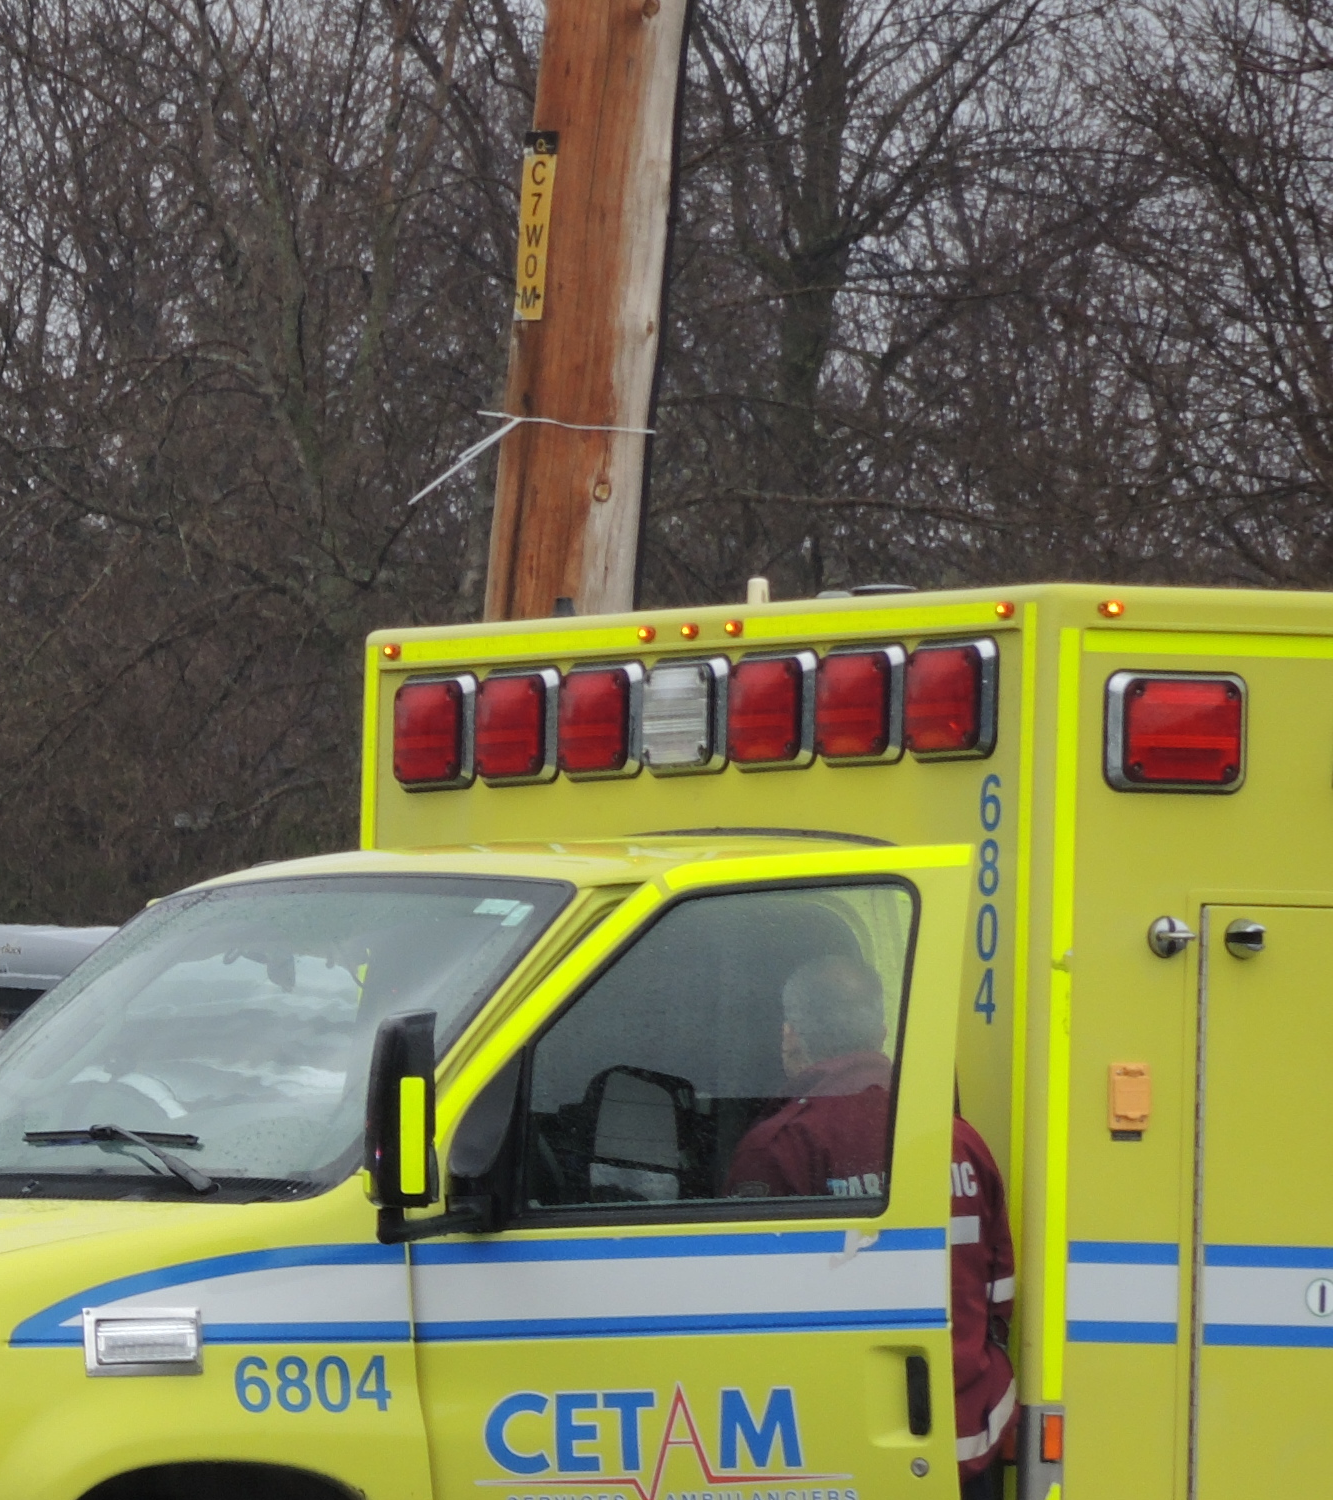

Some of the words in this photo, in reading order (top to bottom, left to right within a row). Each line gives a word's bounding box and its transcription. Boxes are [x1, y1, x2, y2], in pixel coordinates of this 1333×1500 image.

[974, 773, 1002, 1025] 6804
[234, 1354, 393, 1414] 6804
[484, 1383, 804, 1476] CETAM
